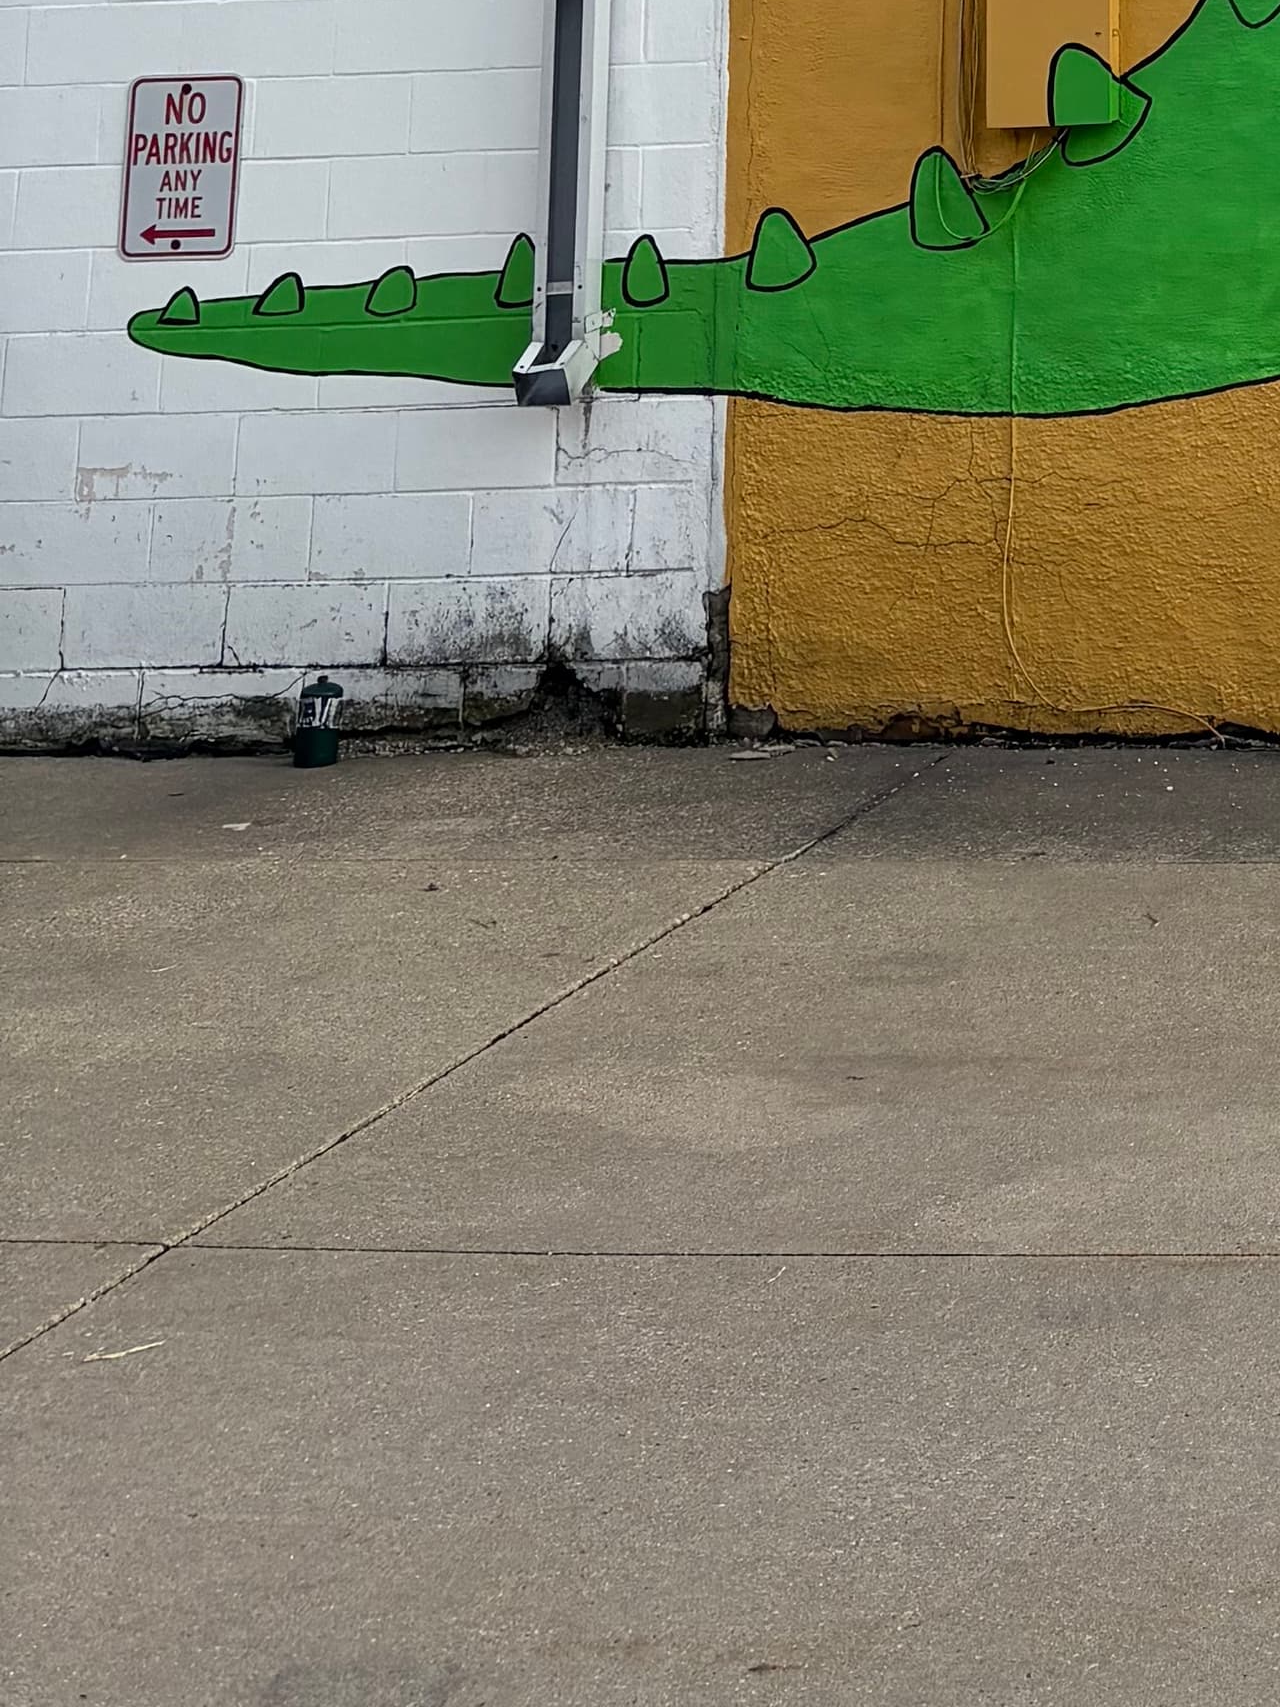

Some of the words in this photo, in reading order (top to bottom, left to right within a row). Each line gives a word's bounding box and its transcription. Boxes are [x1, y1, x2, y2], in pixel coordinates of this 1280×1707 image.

[165, 92, 206, 125] NO
[133, 131, 233, 166] PARKING
[160, 169, 202, 192] ANY
[156, 197, 203, 219] TIME
